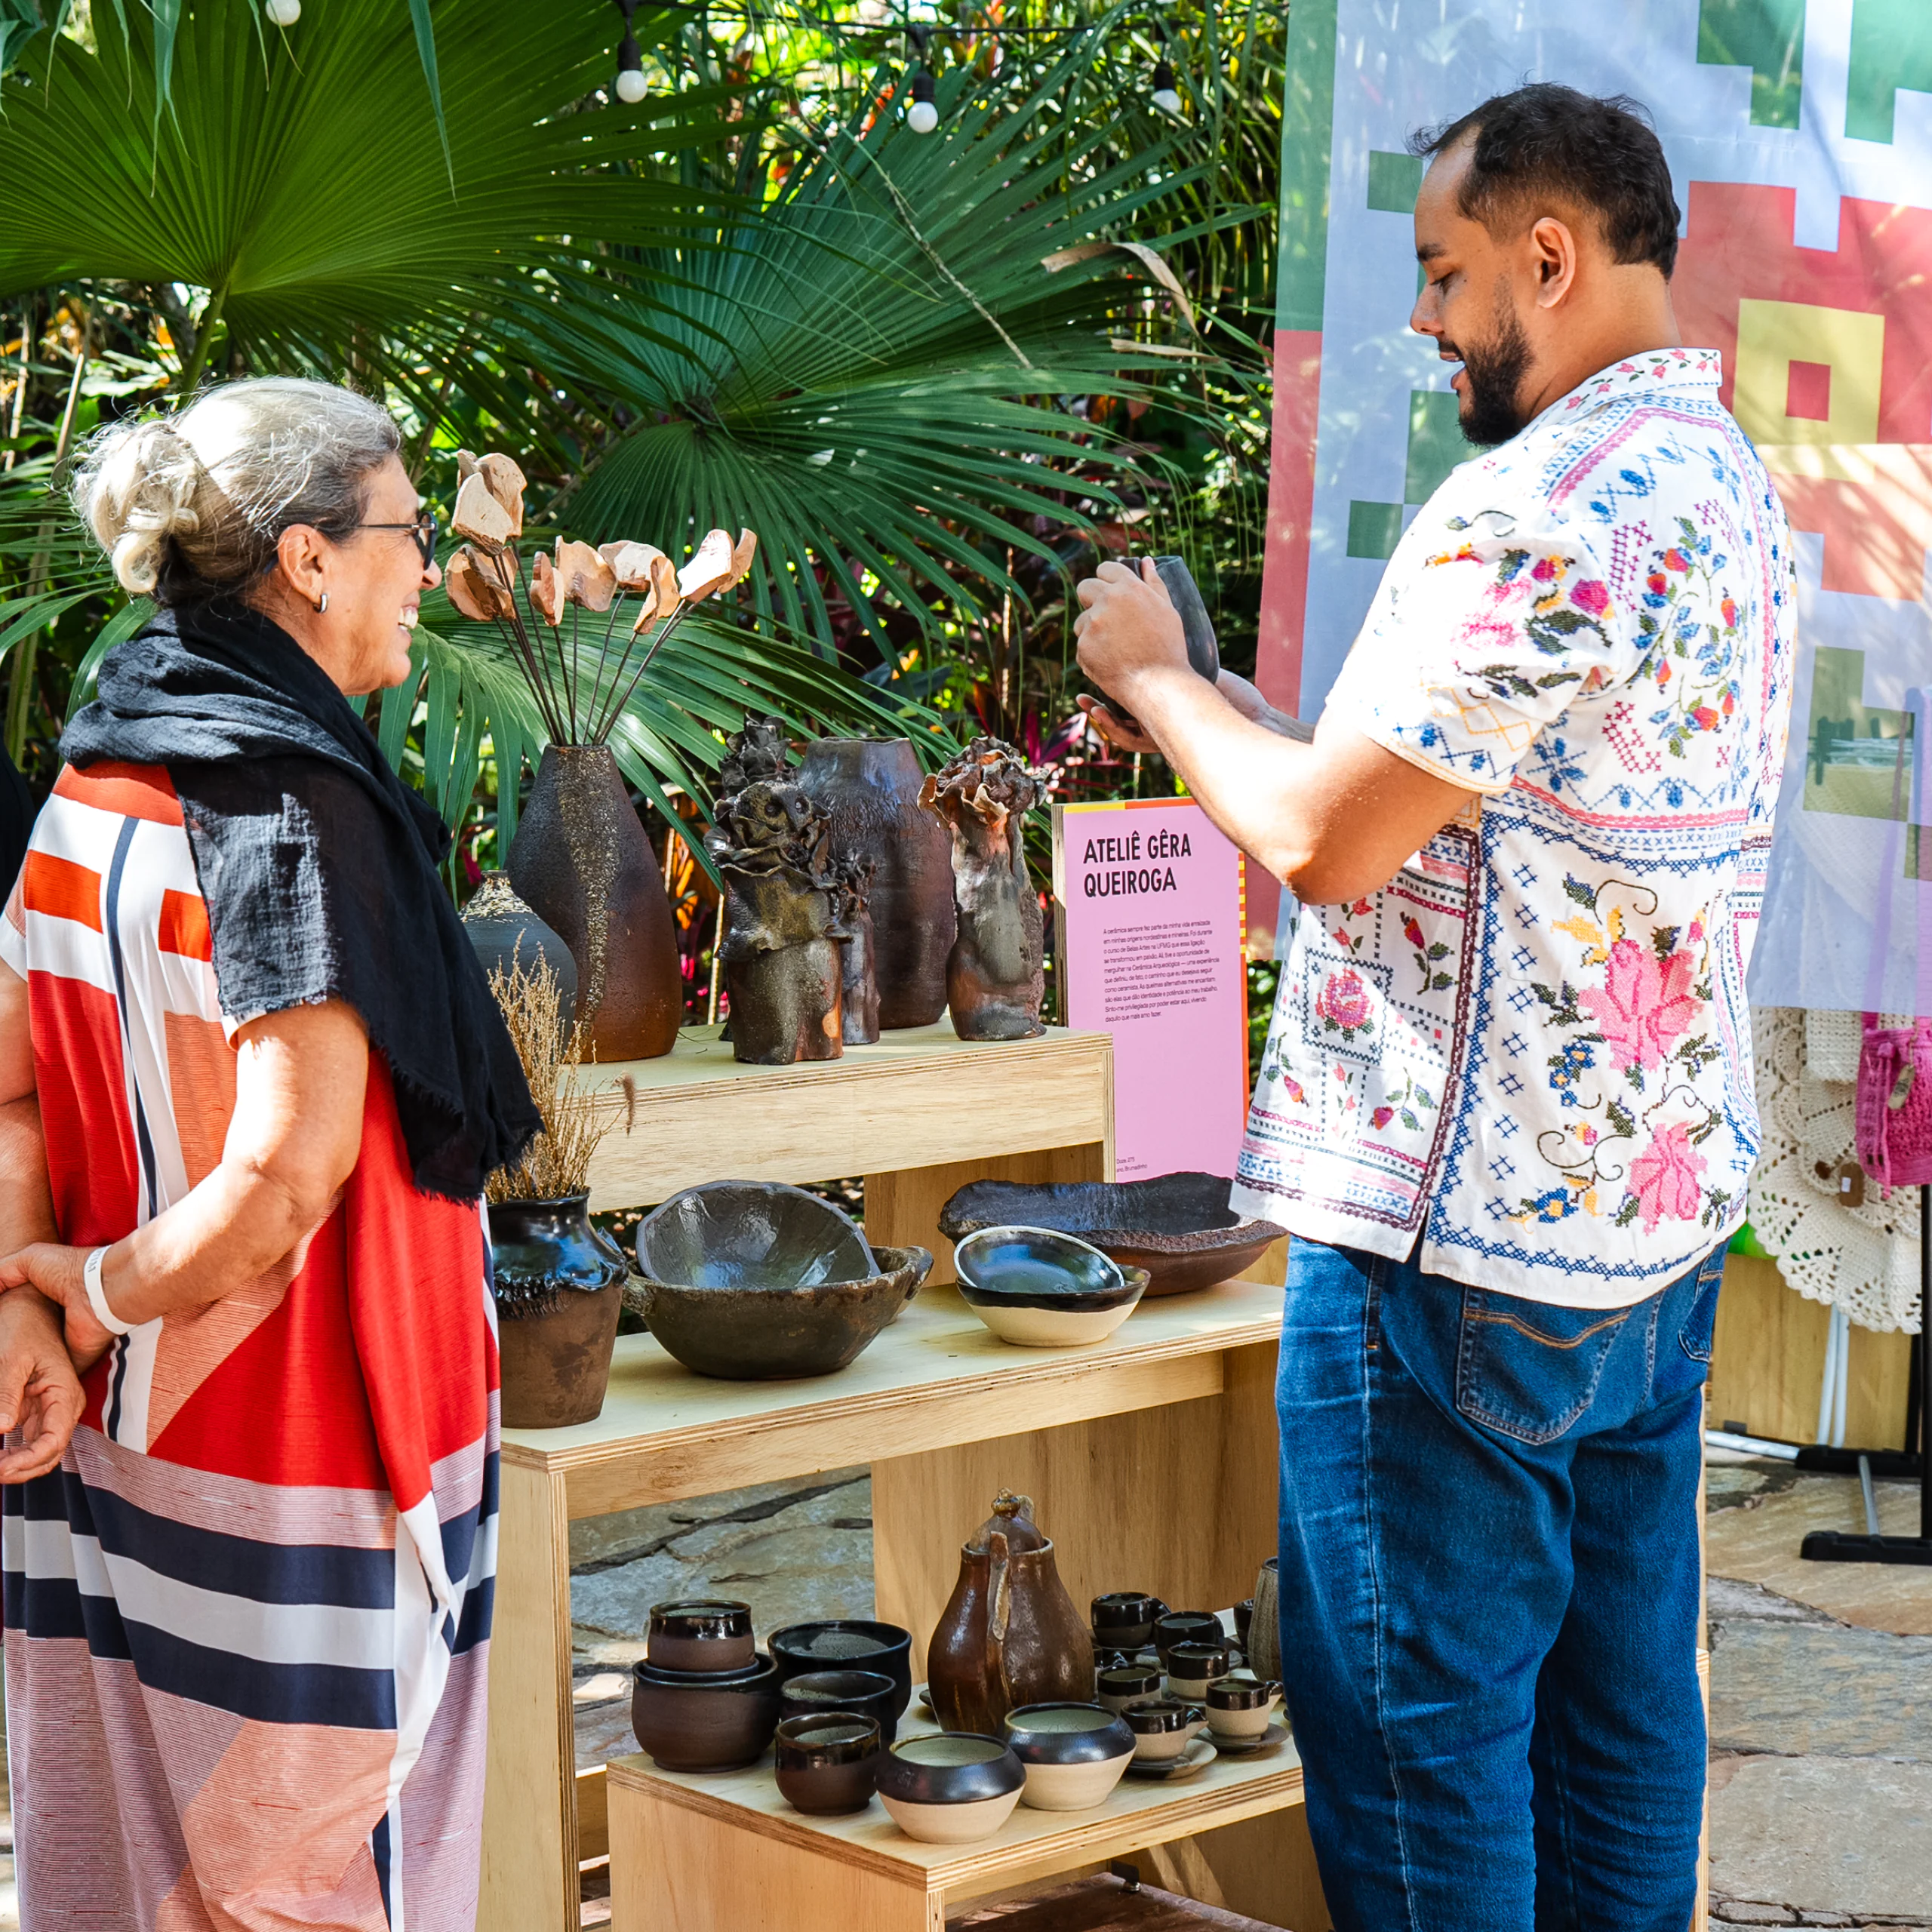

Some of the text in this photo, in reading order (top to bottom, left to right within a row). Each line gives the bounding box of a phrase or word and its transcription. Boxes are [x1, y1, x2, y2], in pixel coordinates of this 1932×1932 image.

[1083, 828, 1192, 864] ATELIÊ GÊRA
[1084, 866, 1177, 898] QUEIROGA
[1191, 939, 1205, 947] ligação
[1177, 949, 1203, 958] oportunidade
[1104, 966, 1124, 974] mergulhar
[1153, 961, 1180, 969] Arqueológica
[1197, 957, 1220, 965] experiência
[1124, 1002, 1148, 1011] privilegiada
